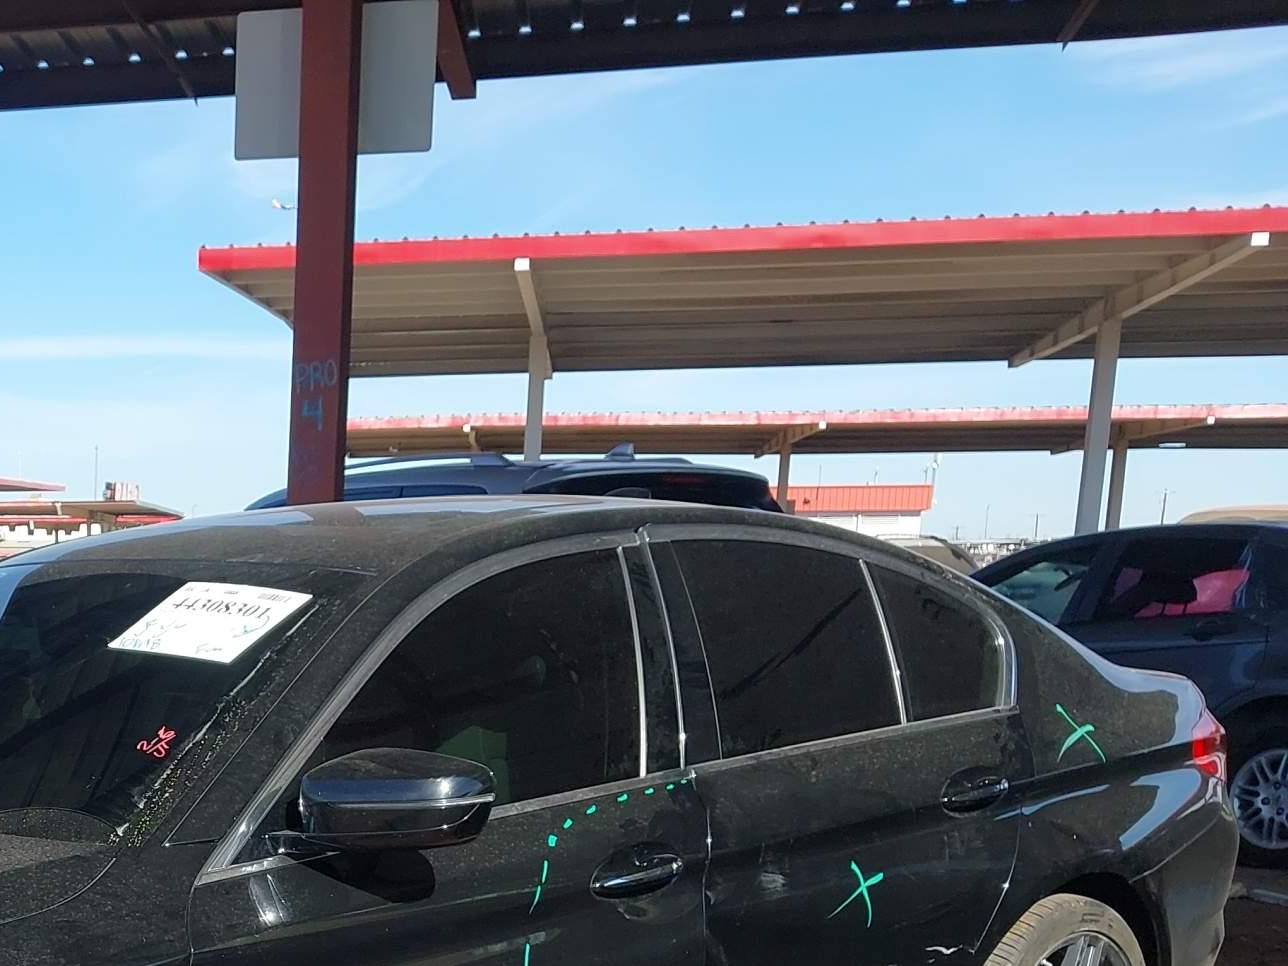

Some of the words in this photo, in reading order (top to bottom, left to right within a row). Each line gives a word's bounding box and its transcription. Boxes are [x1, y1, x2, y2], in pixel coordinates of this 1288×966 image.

[295, 359, 338, 393] PRO
[301, 396, 324, 432] 4
[172, 597, 271, 619] 44308301
